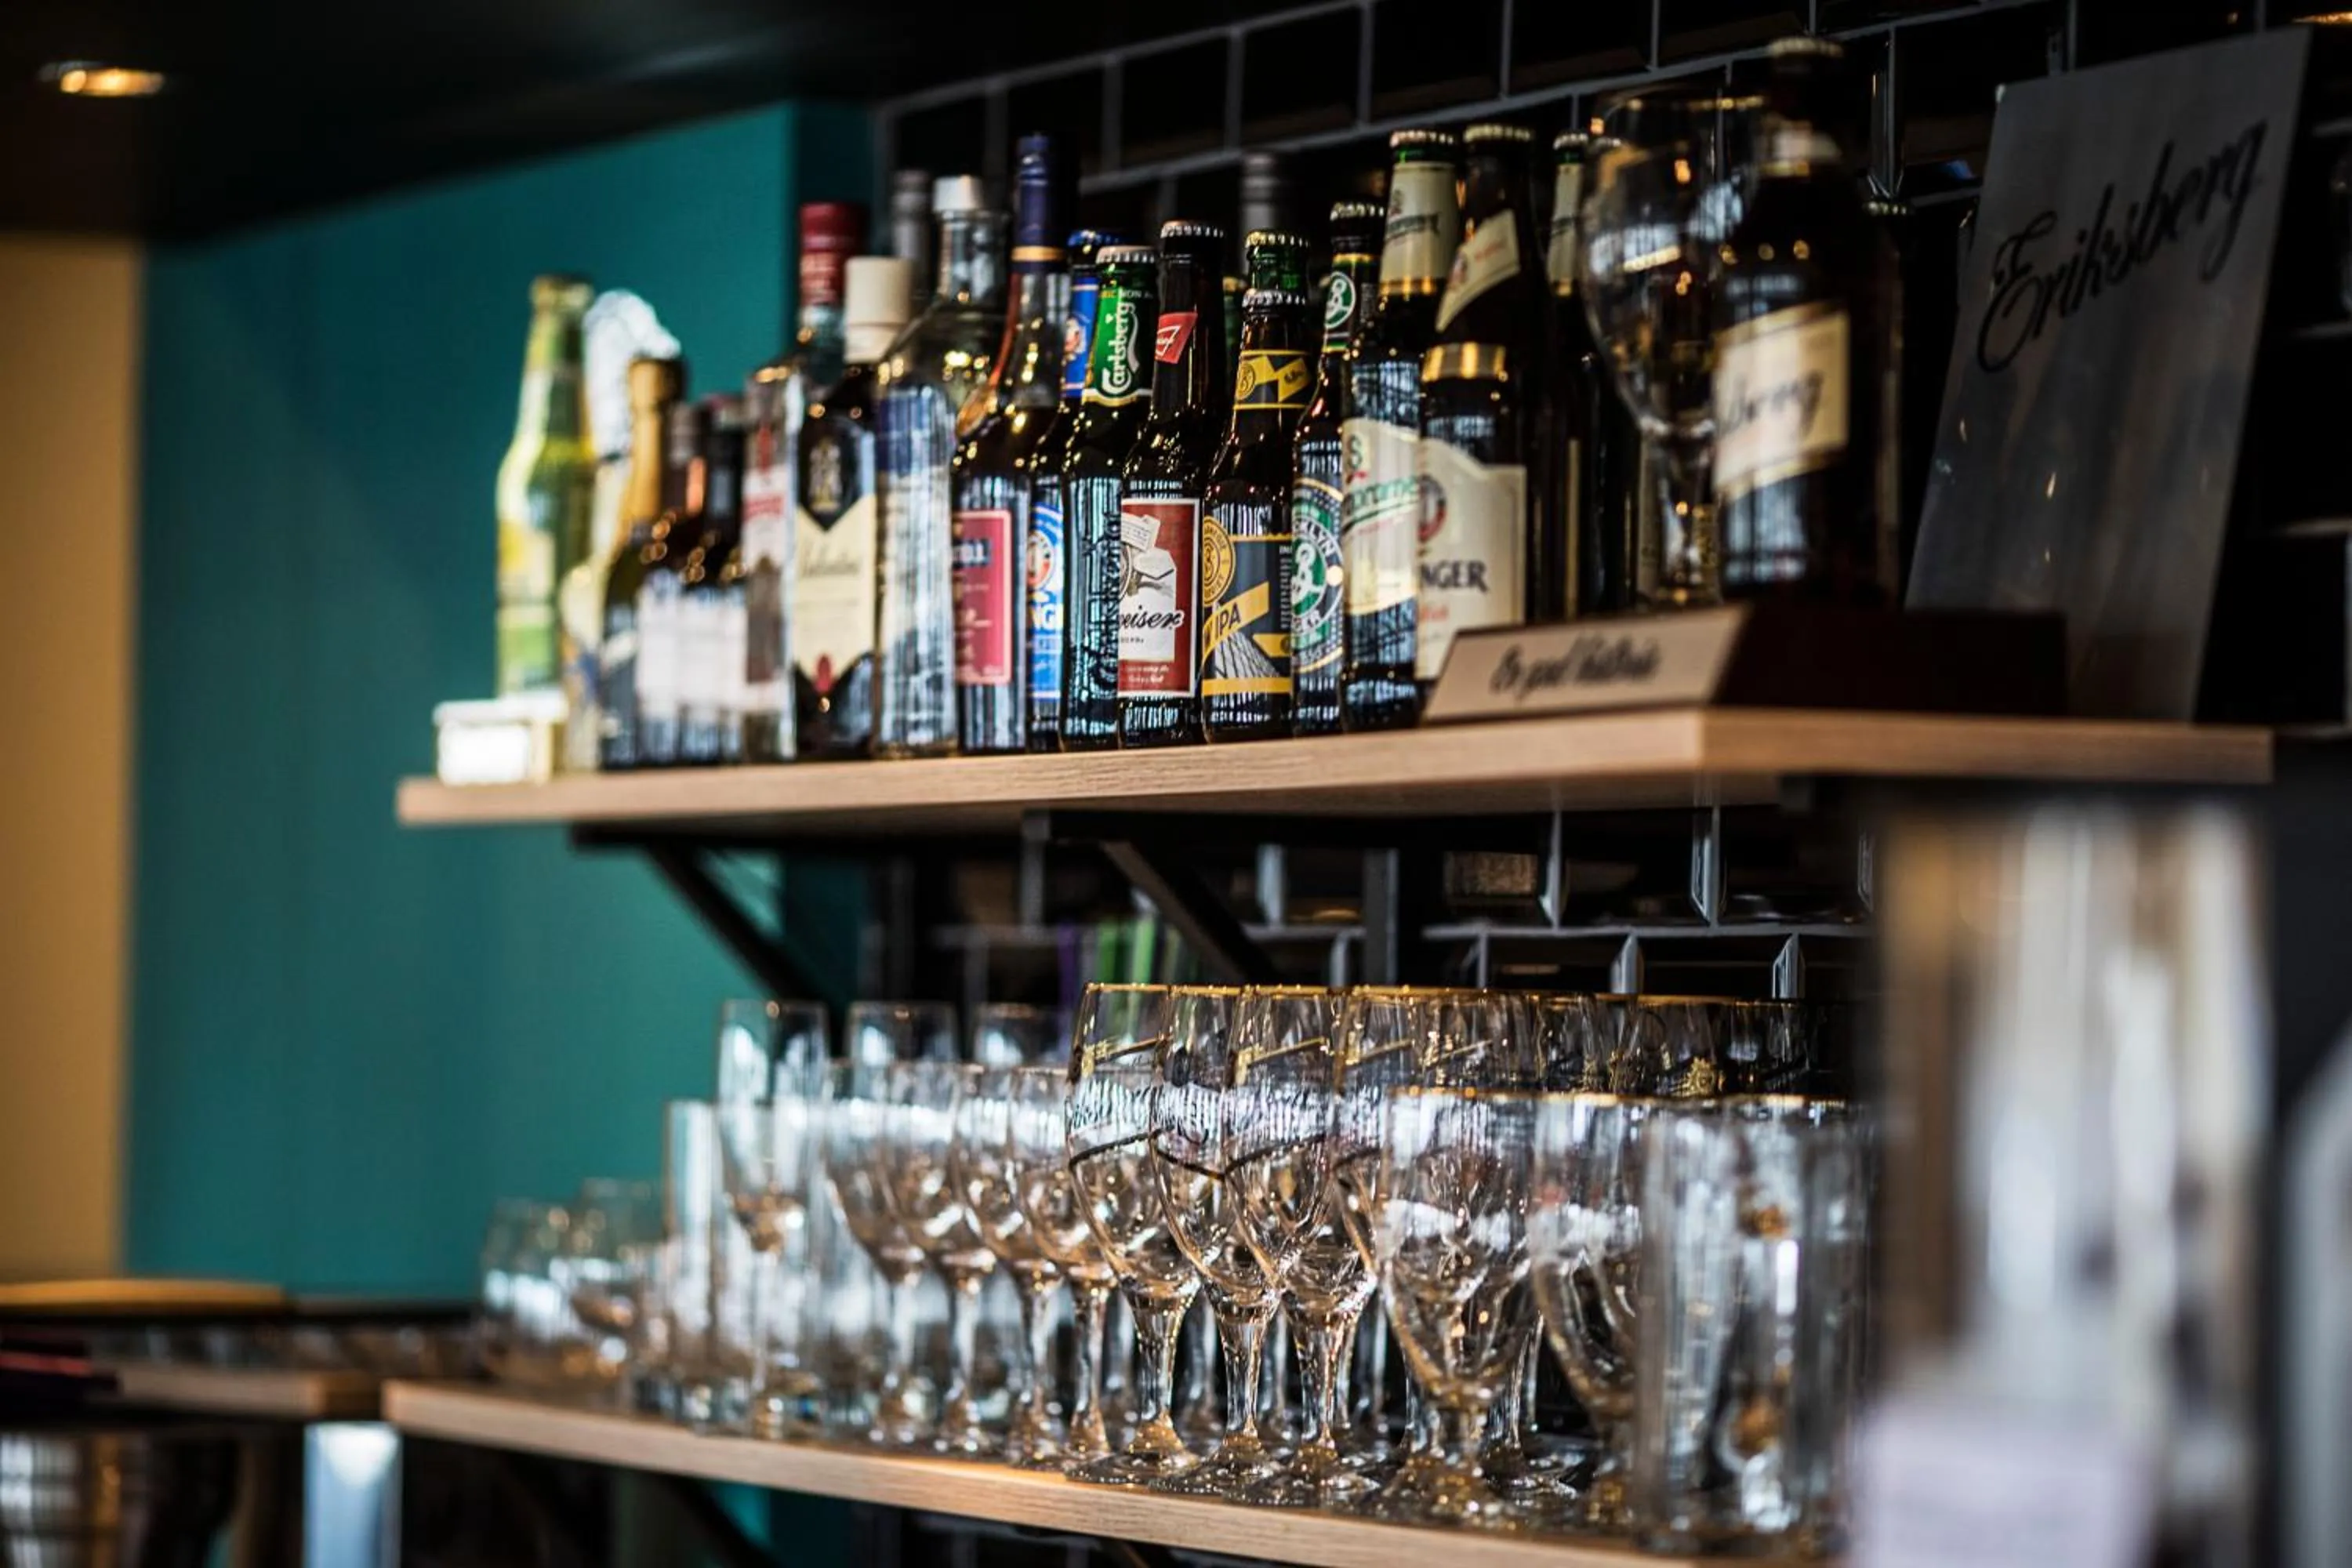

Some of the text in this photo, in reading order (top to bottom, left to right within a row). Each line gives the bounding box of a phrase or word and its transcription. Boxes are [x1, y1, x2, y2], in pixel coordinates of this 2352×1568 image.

[1977, 119, 2267, 373] Eriksberg
[1102, 301, 1139, 395] Carlsberg
[1214, 601, 1241, 641] IPA
